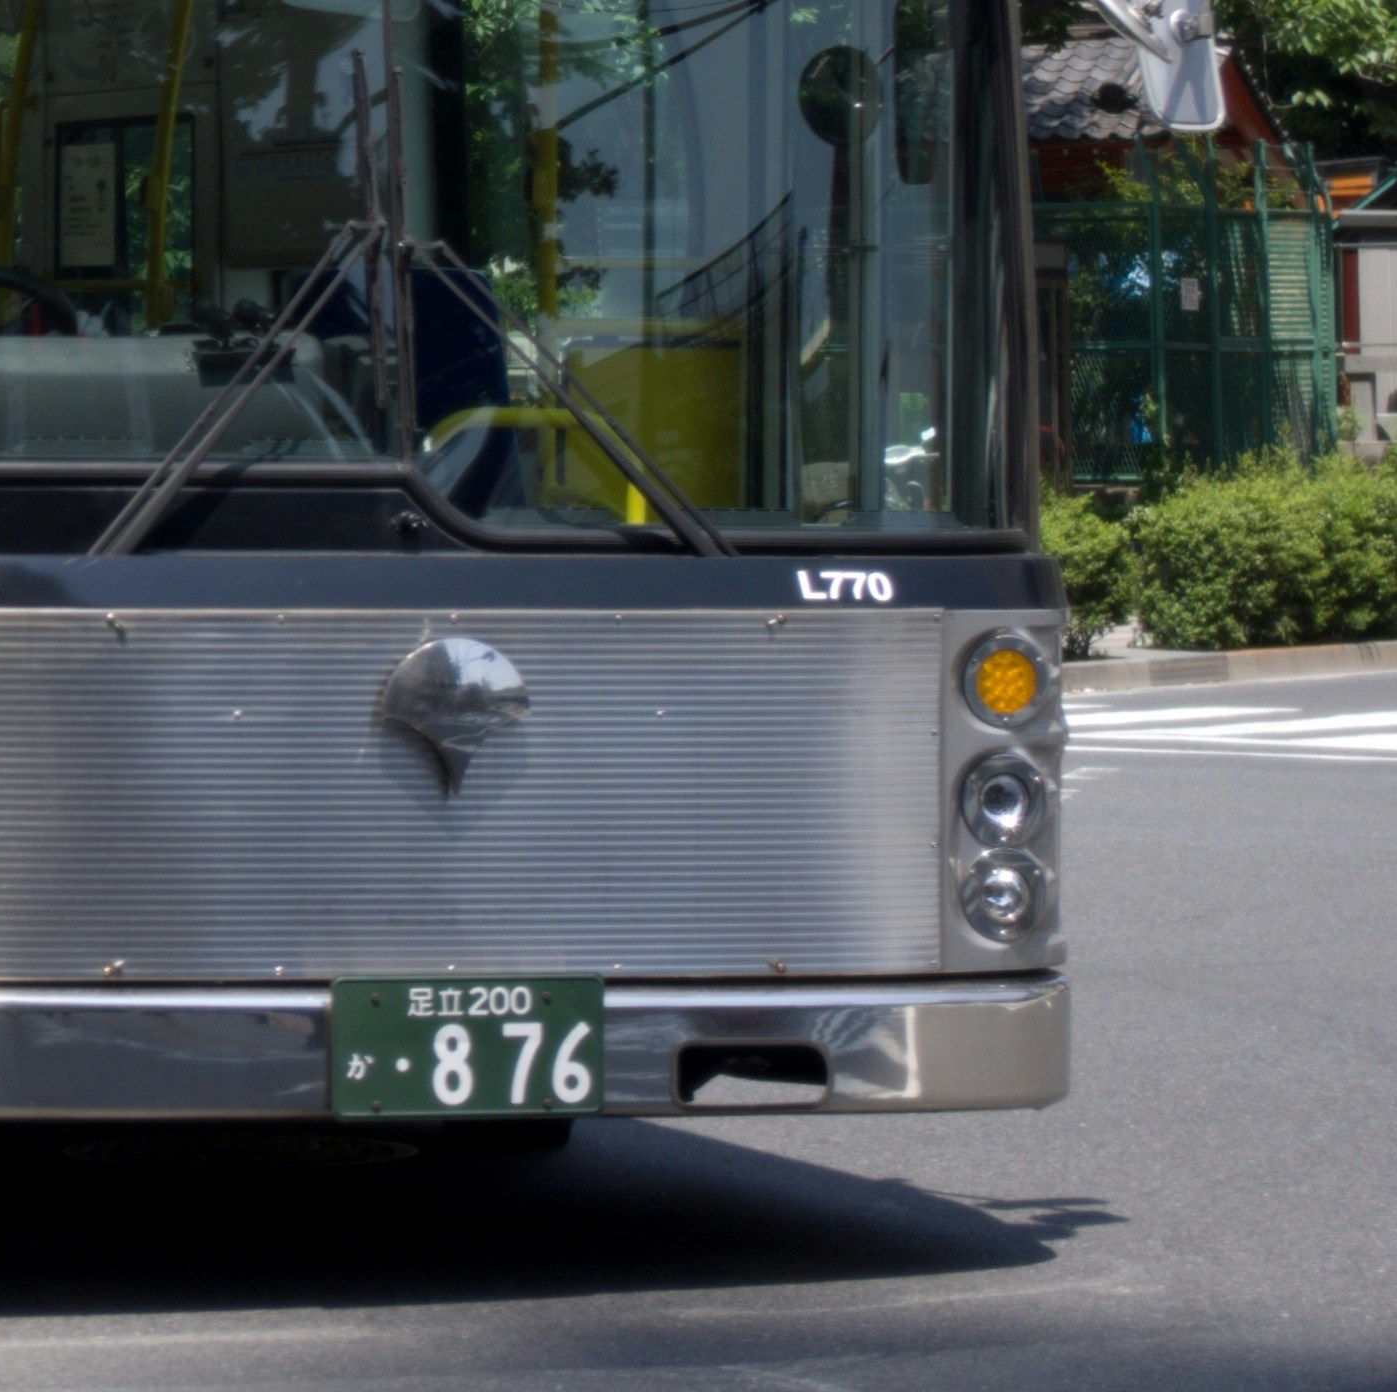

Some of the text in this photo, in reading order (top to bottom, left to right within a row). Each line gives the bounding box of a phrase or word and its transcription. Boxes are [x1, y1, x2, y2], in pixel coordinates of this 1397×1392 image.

[796, 569, 894, 602] L770
[406, 985, 533, 1018] 足立200
[346, 1052, 375, 1081] か
